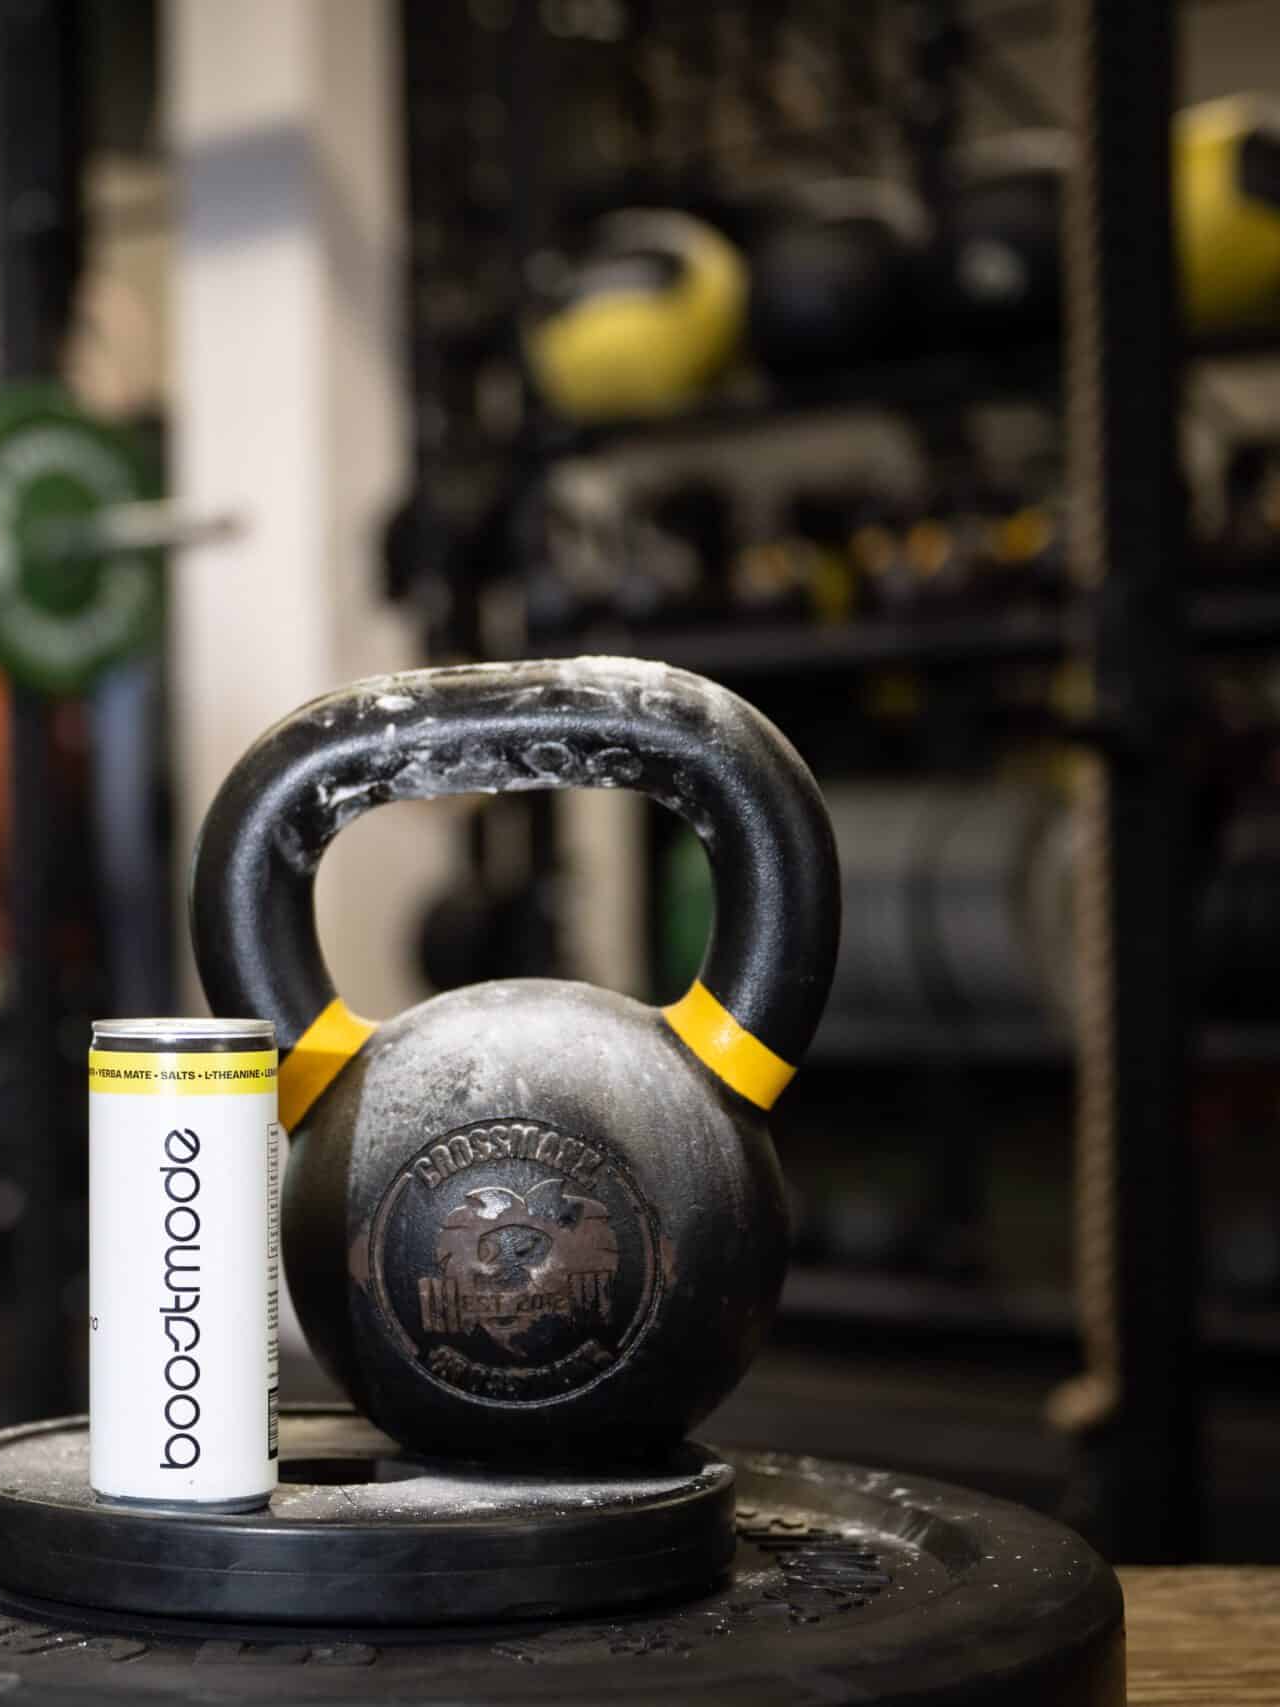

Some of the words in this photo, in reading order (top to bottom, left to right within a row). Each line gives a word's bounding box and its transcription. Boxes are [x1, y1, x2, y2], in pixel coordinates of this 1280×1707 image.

[123, 1070, 152, 1080] MATE
[160, 1070, 195, 1080] SALTS
[204, 1069, 261, 1080] L-THEANINE
[159, 1127, 201, 1469] boostmode
